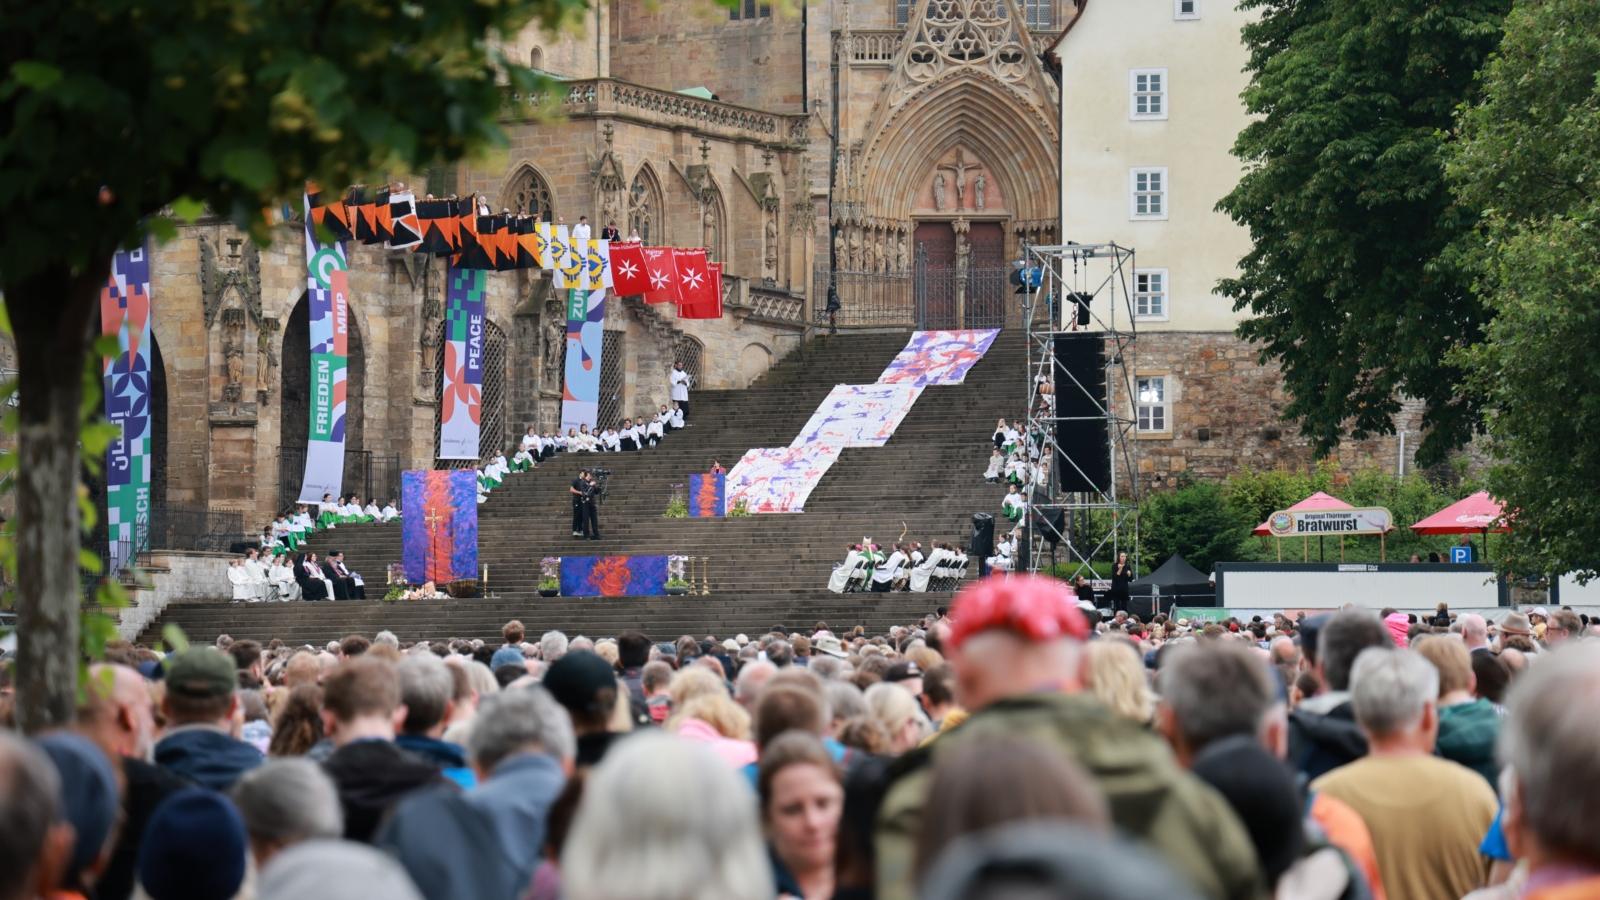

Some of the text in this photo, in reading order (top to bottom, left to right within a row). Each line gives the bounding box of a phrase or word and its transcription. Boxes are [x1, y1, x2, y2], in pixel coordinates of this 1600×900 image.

[469, 314, 482, 370] PEACE
[316, 360, 330, 435] FRIEDEN
[136, 487, 148, 553] ENSCH
[1297, 518, 1358, 532] Bratwurst
[1455, 549, 1466, 563] P
